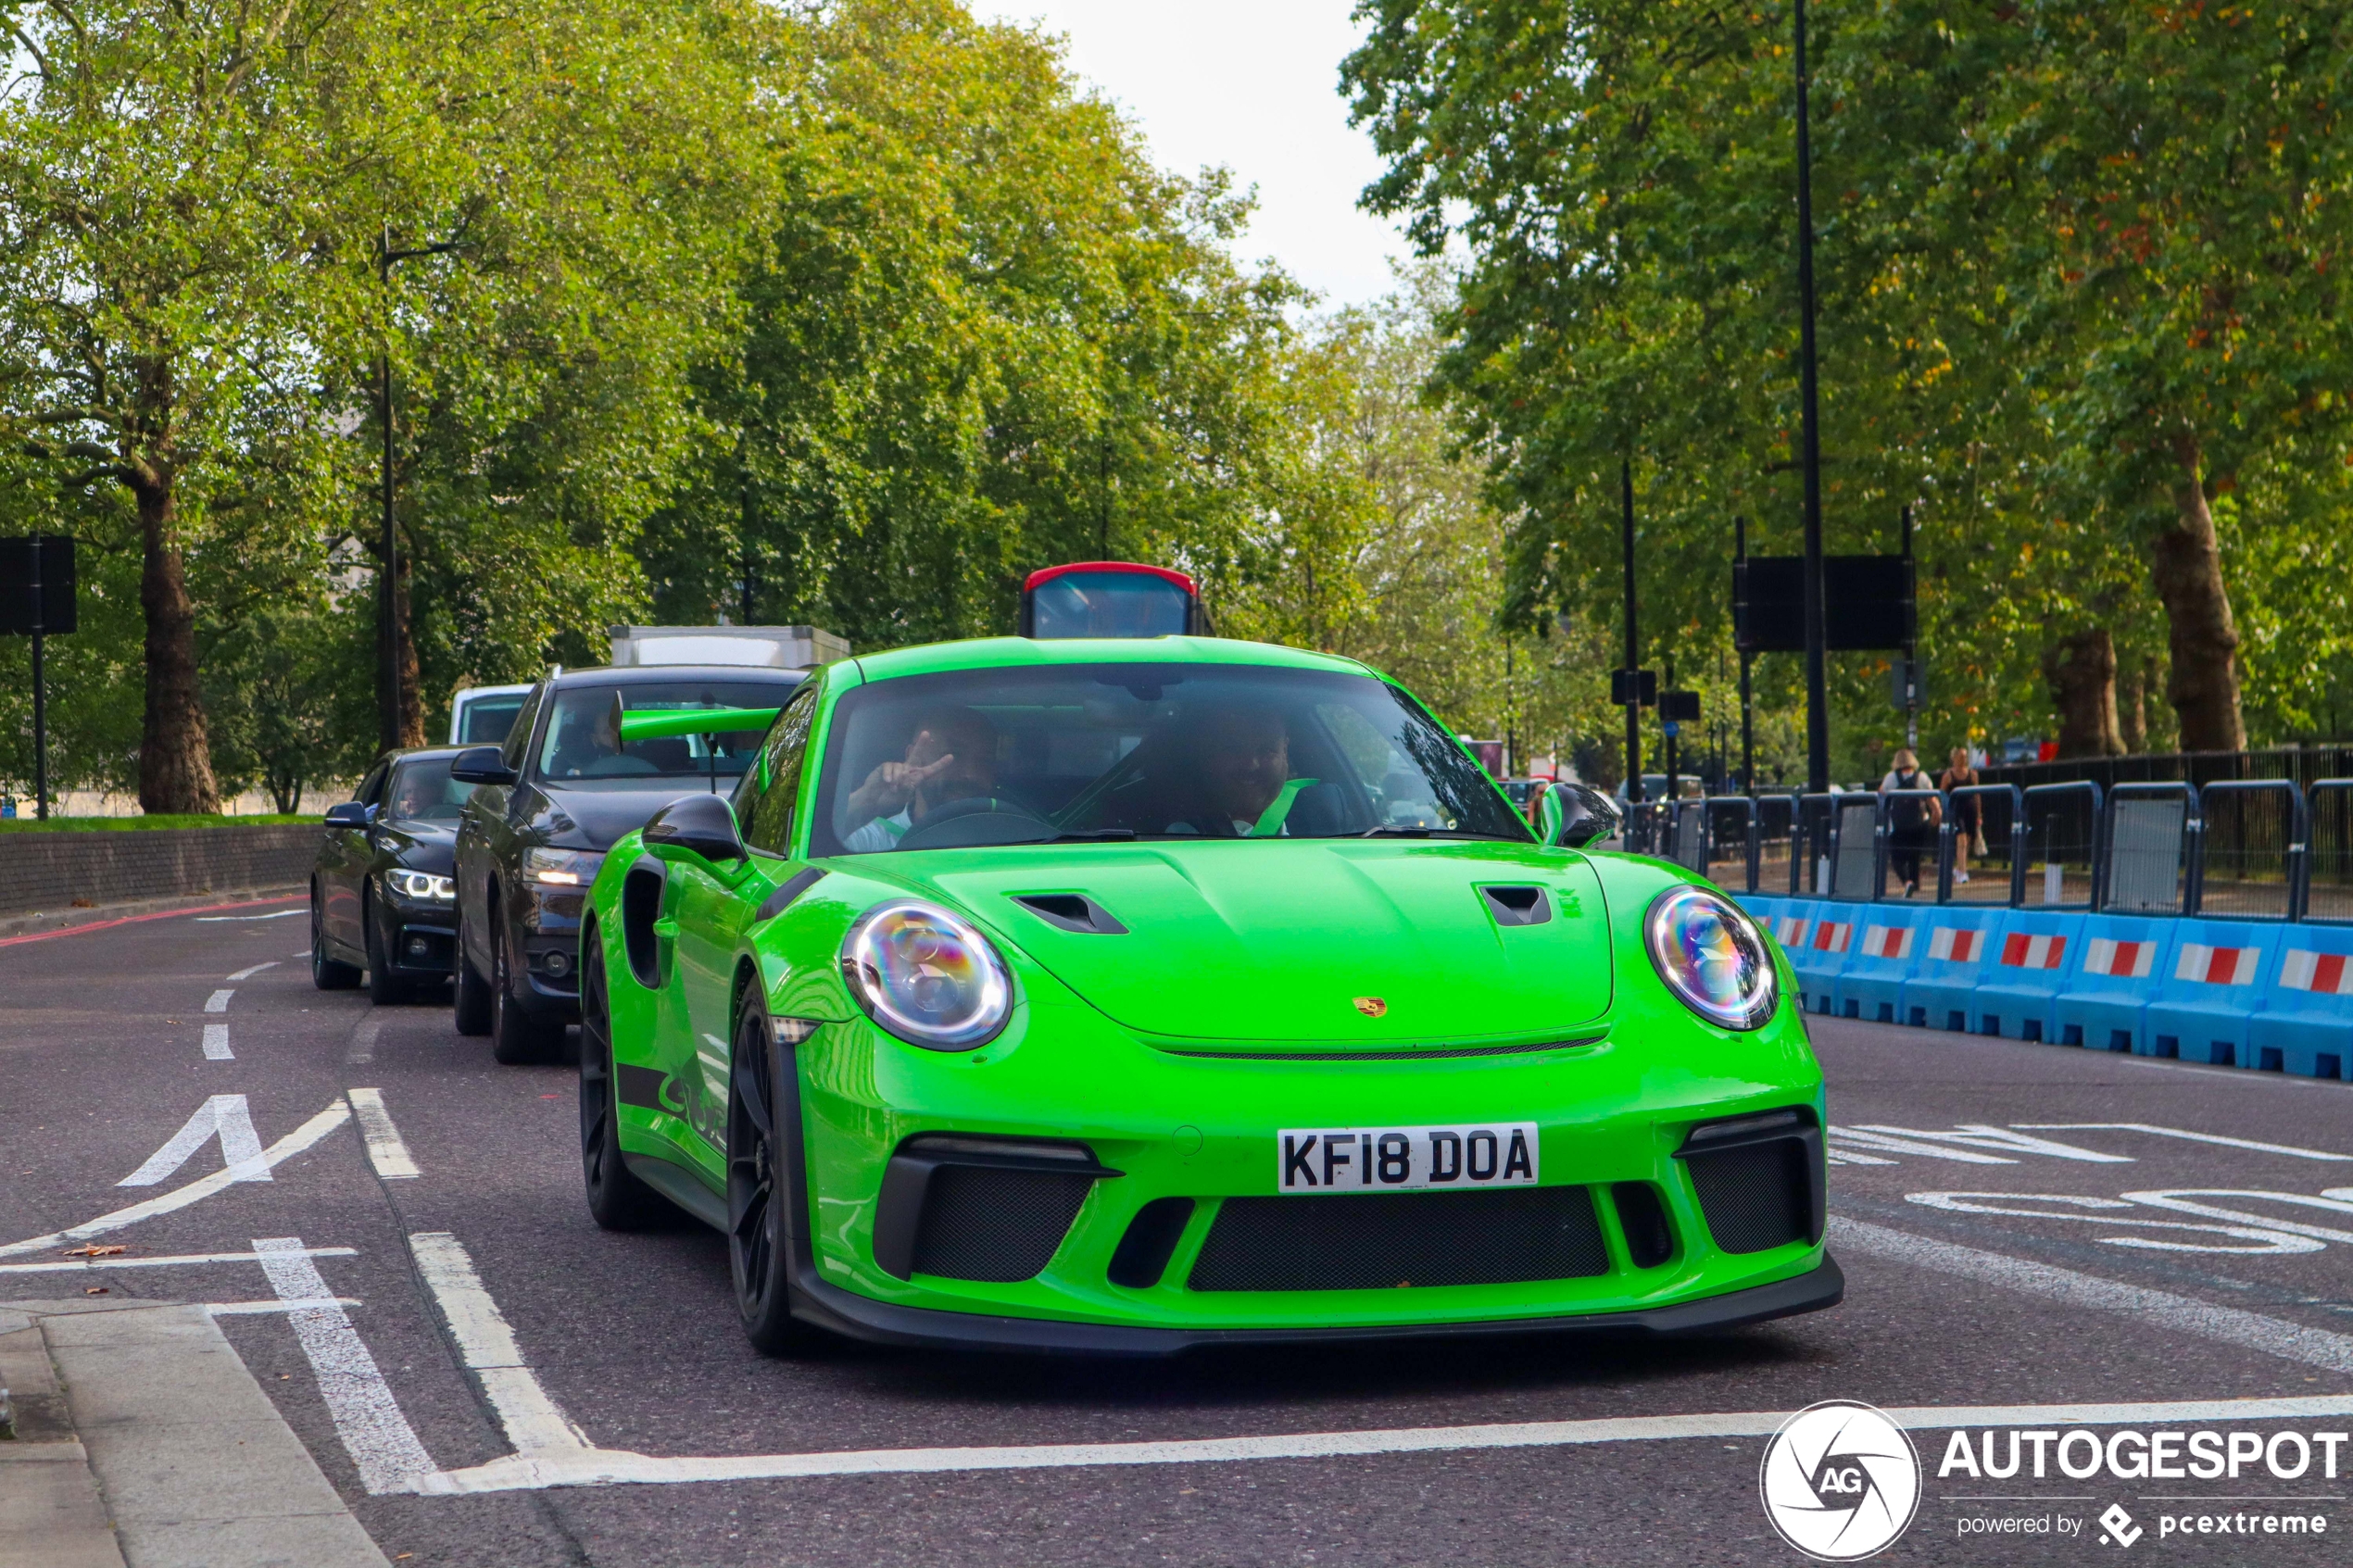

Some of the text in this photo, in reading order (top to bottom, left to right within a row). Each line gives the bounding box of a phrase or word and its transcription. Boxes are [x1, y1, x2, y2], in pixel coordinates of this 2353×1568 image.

[1284, 1128, 1533, 1187] KF18 DOA
[1828, 1123, 2353, 1164] LAN
[1904, 1187, 2353, 1254] US
